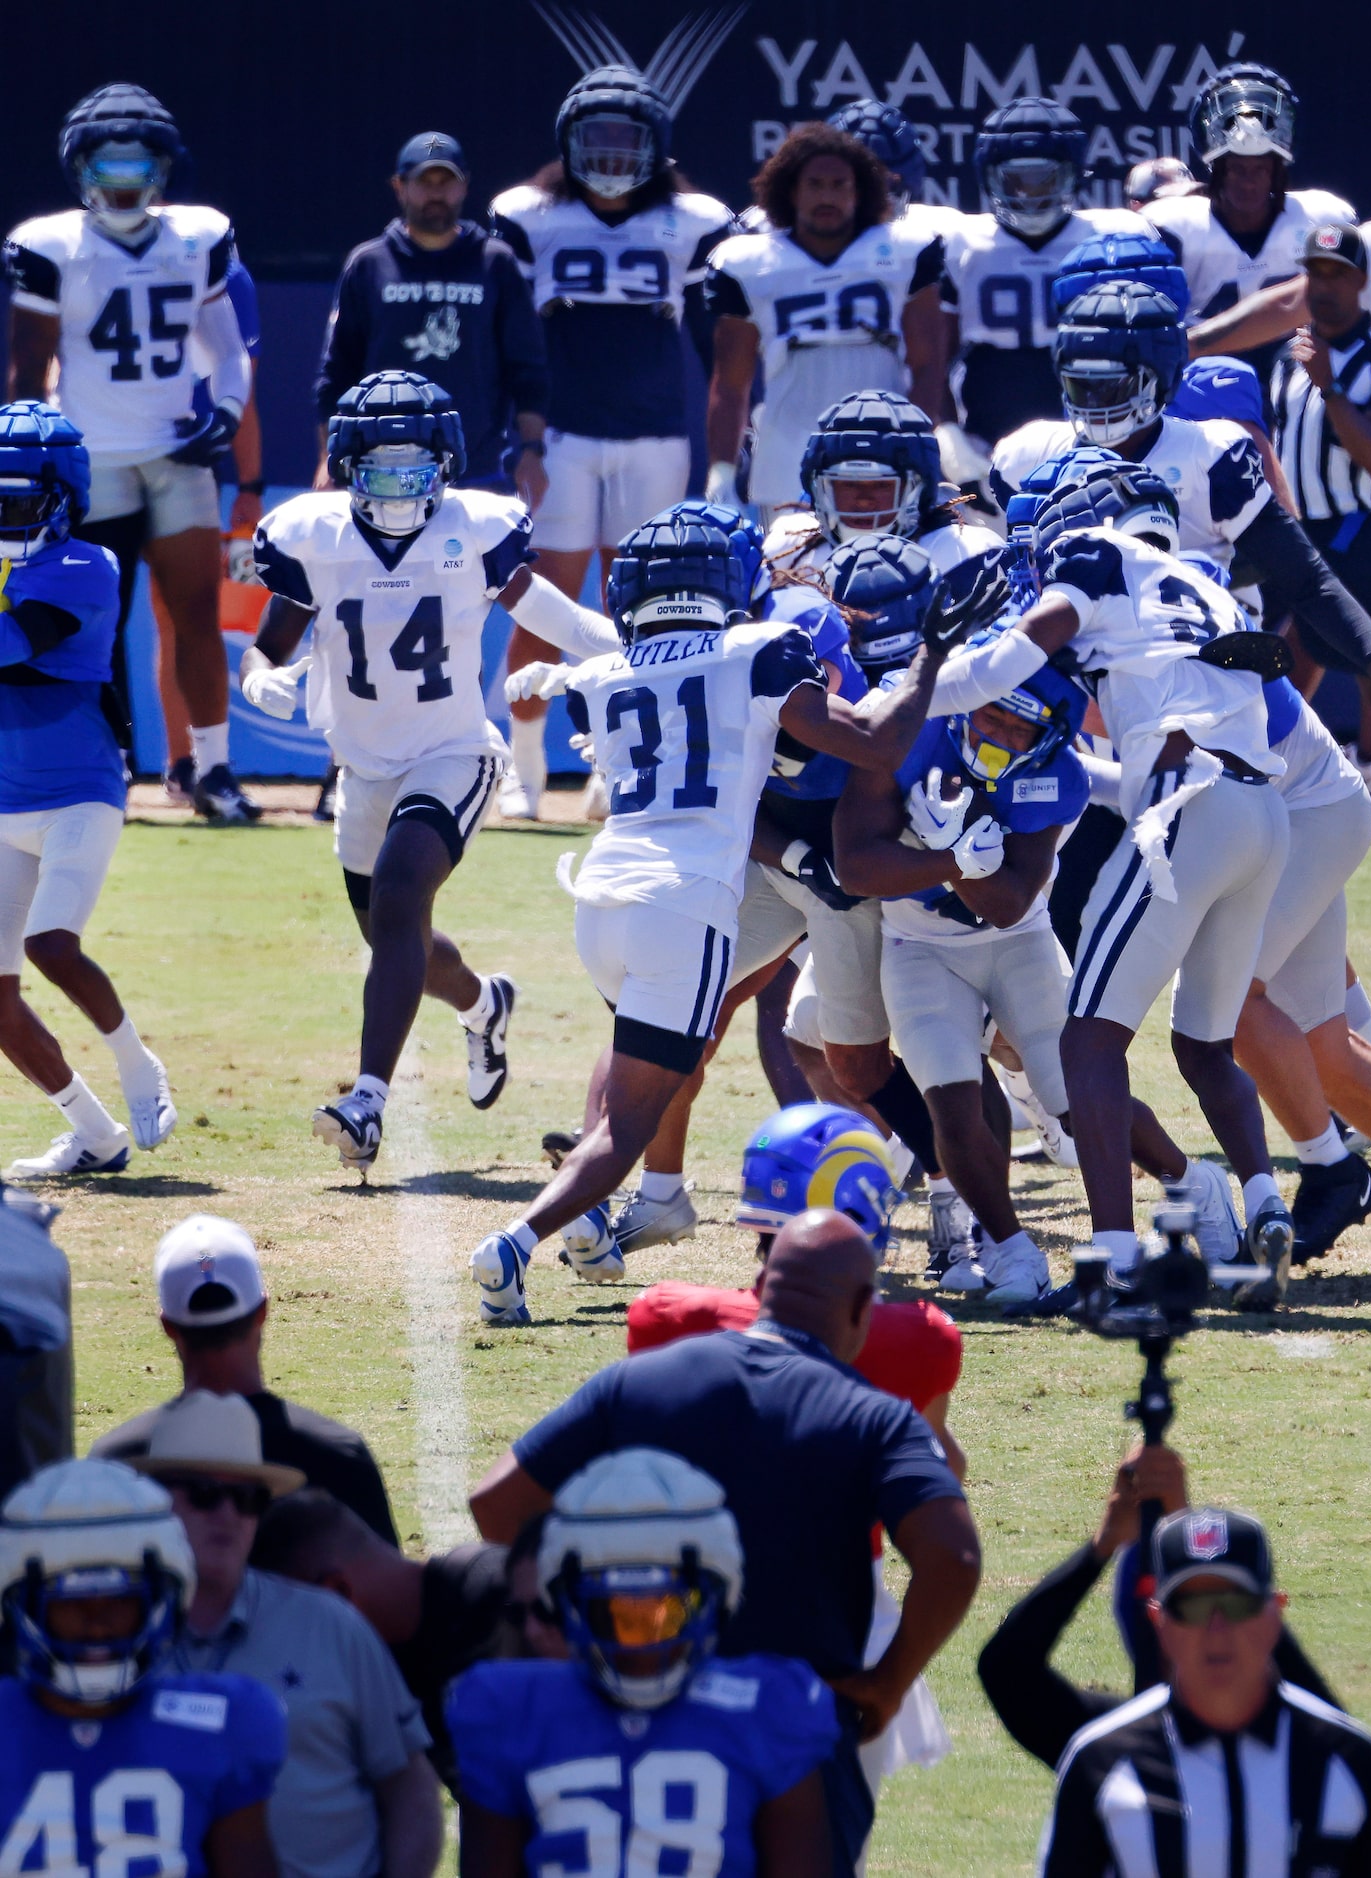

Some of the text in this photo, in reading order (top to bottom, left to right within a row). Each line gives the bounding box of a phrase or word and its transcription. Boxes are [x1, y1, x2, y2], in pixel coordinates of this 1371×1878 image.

[381, 281, 485, 305] COWBOYS
[552, 249, 670, 300] 93
[88, 283, 193, 382] 45
[371, 580, 411, 589] COWBOYS
[443, 559, 464, 569] AT&T
[657, 605, 703, 615] COWBOYS
[336, 595, 454, 703] 14
[606, 675, 719, 816] 31
[1031, 783, 1057, 792] UNIFY
[0, 1769, 188, 1878] 48
[525, 1749, 729, 1878] 58
